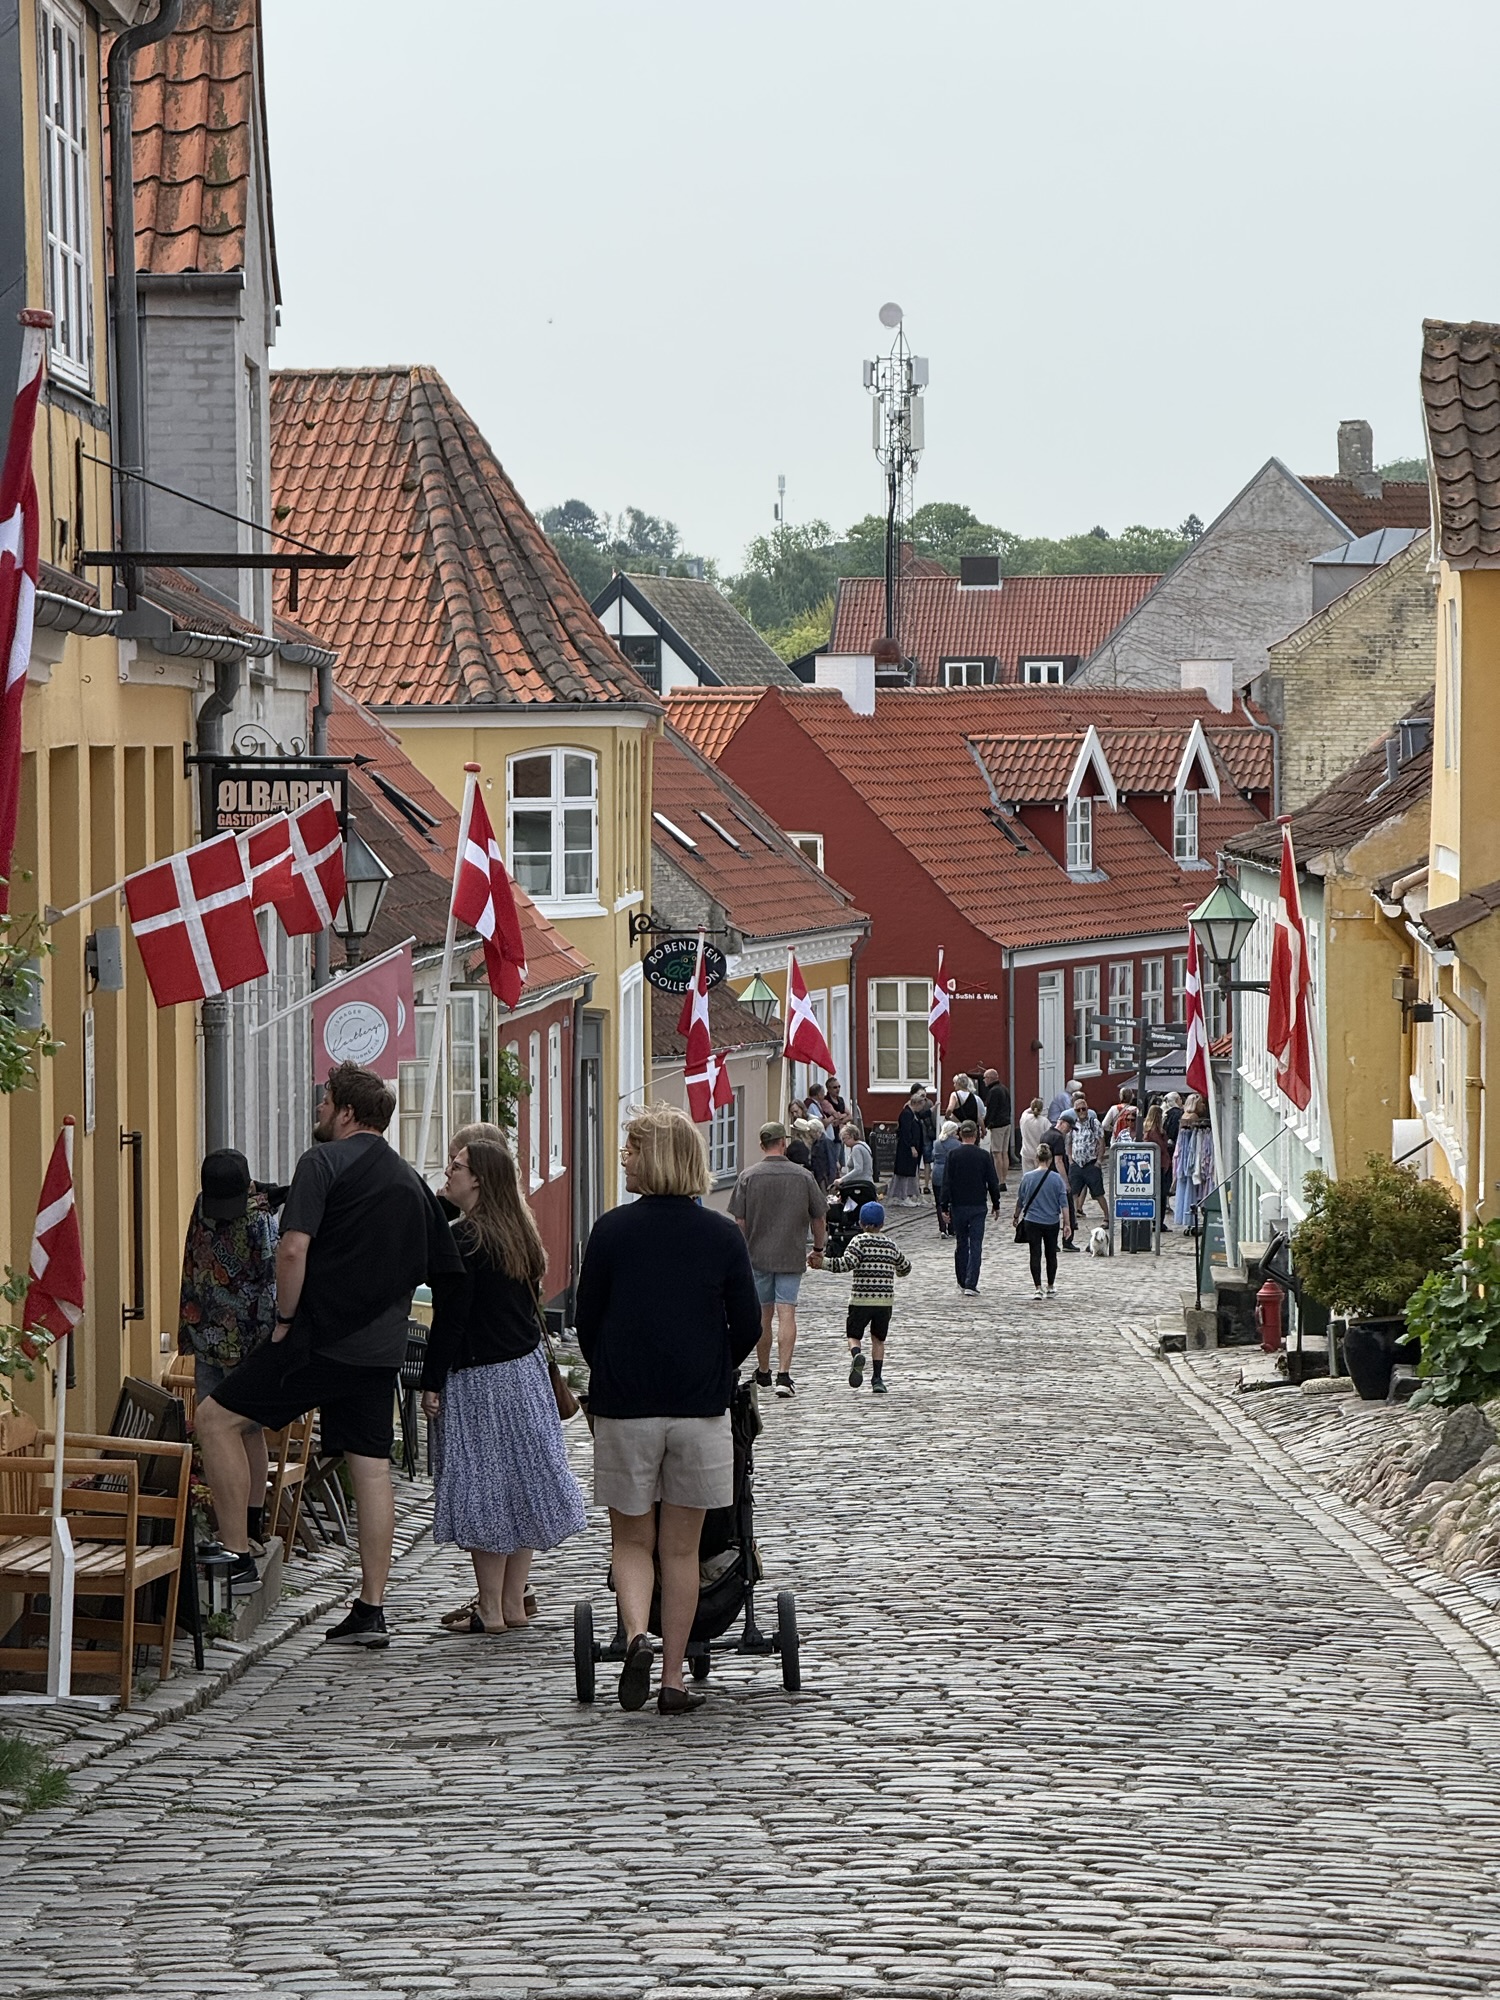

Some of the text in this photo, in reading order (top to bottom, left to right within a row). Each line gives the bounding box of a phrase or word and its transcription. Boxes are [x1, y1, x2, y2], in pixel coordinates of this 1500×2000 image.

[216, 780, 342, 812] ØLBAREN
[217, 813, 274, 826] GASTROP
[648, 941, 721, 965] BO BENDEN
[650, 970, 720, 992] COLLECON
[1124, 1185, 1146, 1193] Zone
